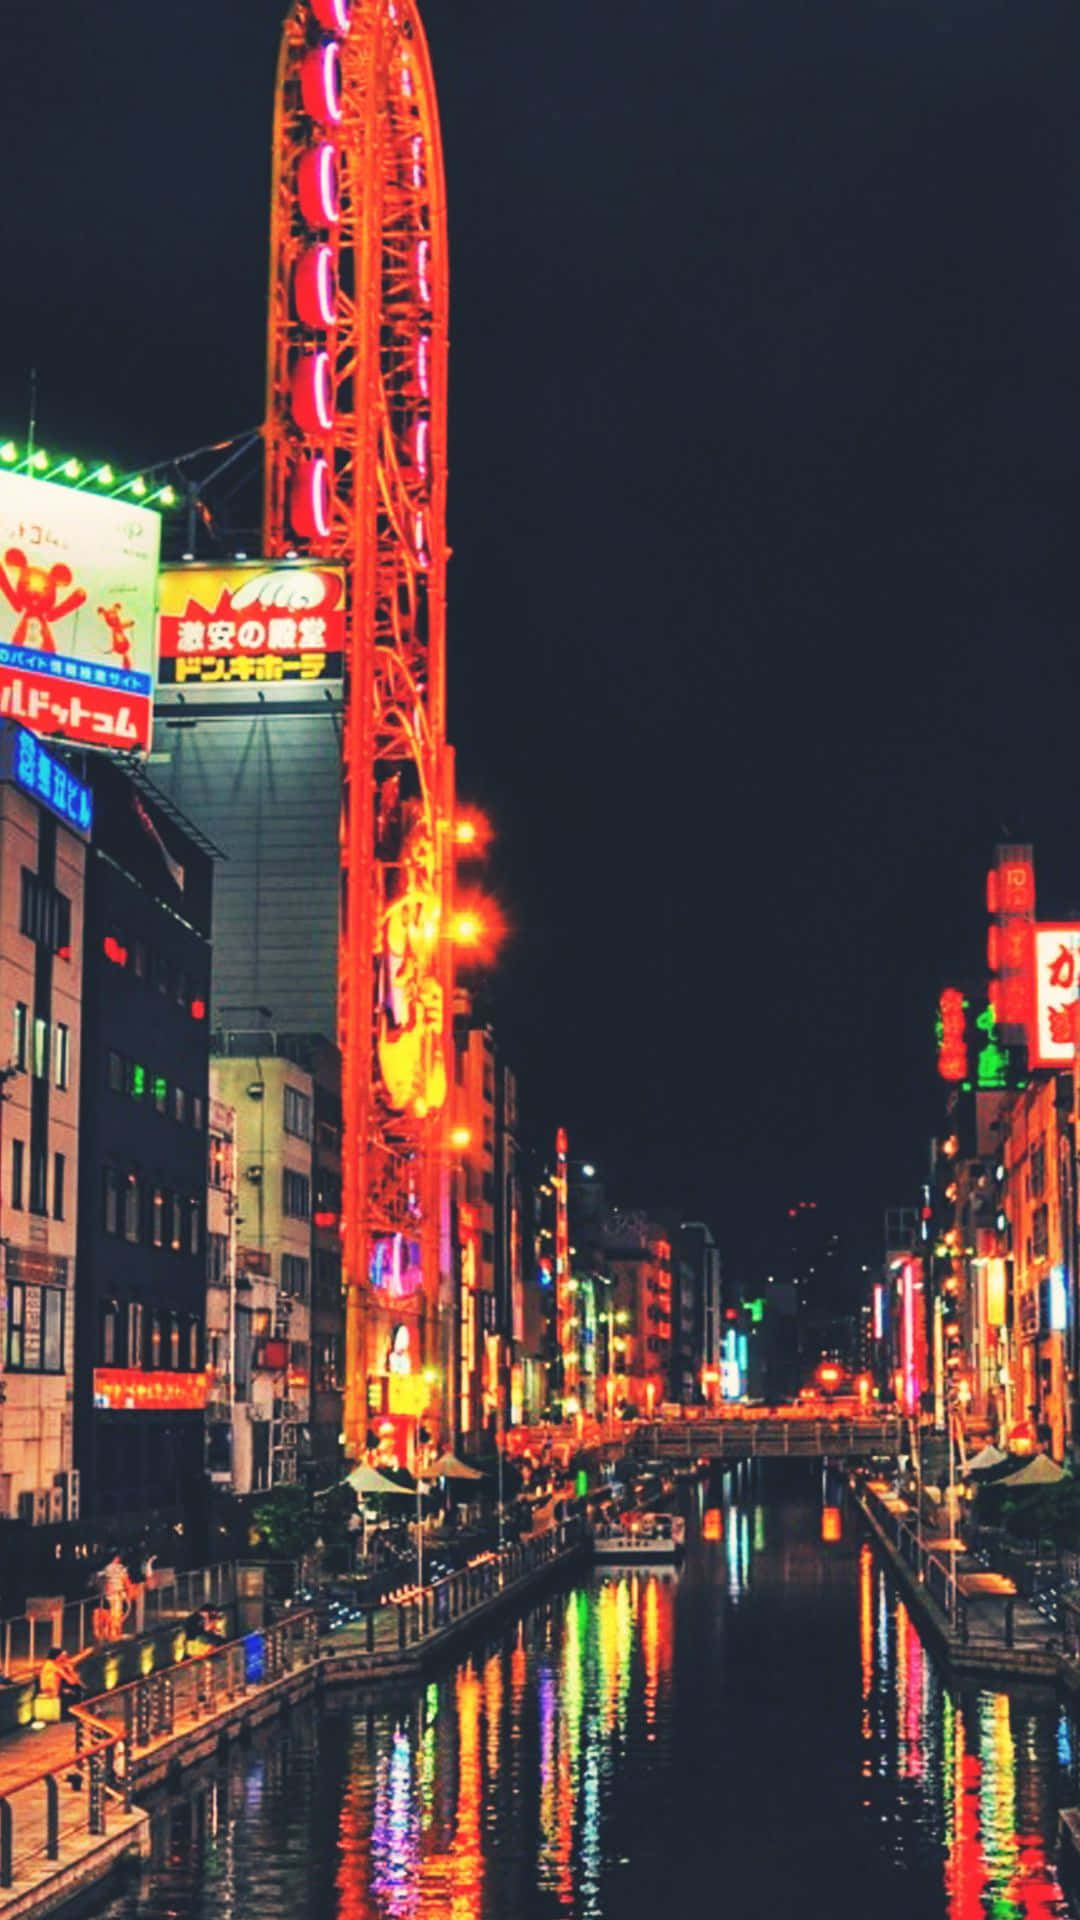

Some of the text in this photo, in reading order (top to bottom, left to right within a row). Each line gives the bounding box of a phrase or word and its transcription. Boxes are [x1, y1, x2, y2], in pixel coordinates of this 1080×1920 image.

[177, 616, 327, 653] 激安の殿堂
